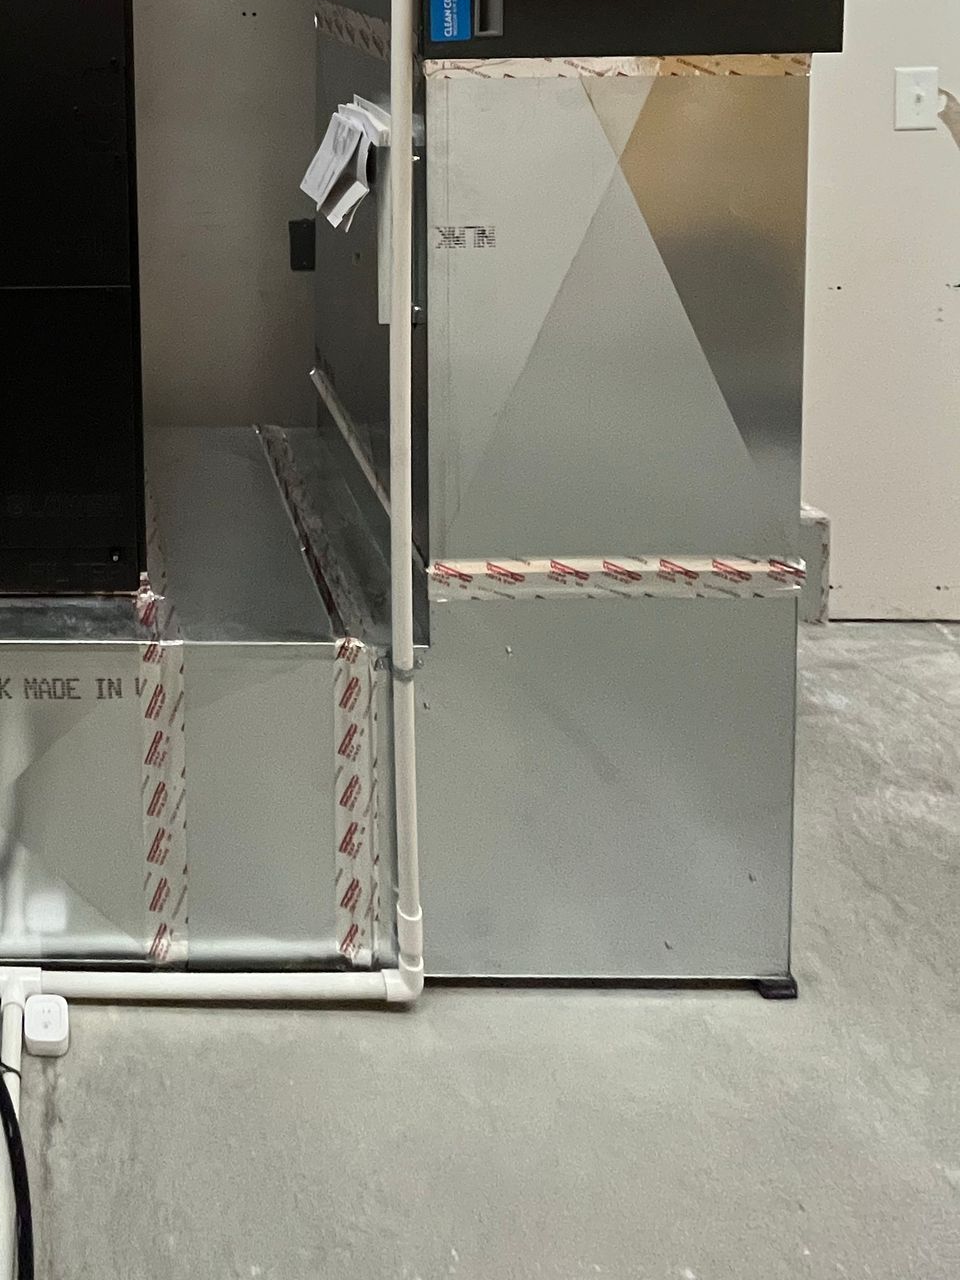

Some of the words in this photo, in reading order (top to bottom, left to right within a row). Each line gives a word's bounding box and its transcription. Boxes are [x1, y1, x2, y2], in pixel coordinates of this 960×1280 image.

[443, 9, 453, 37] CLEAN
[23, 677, 82, 700] MADE
[95, 677, 123, 700] IN
